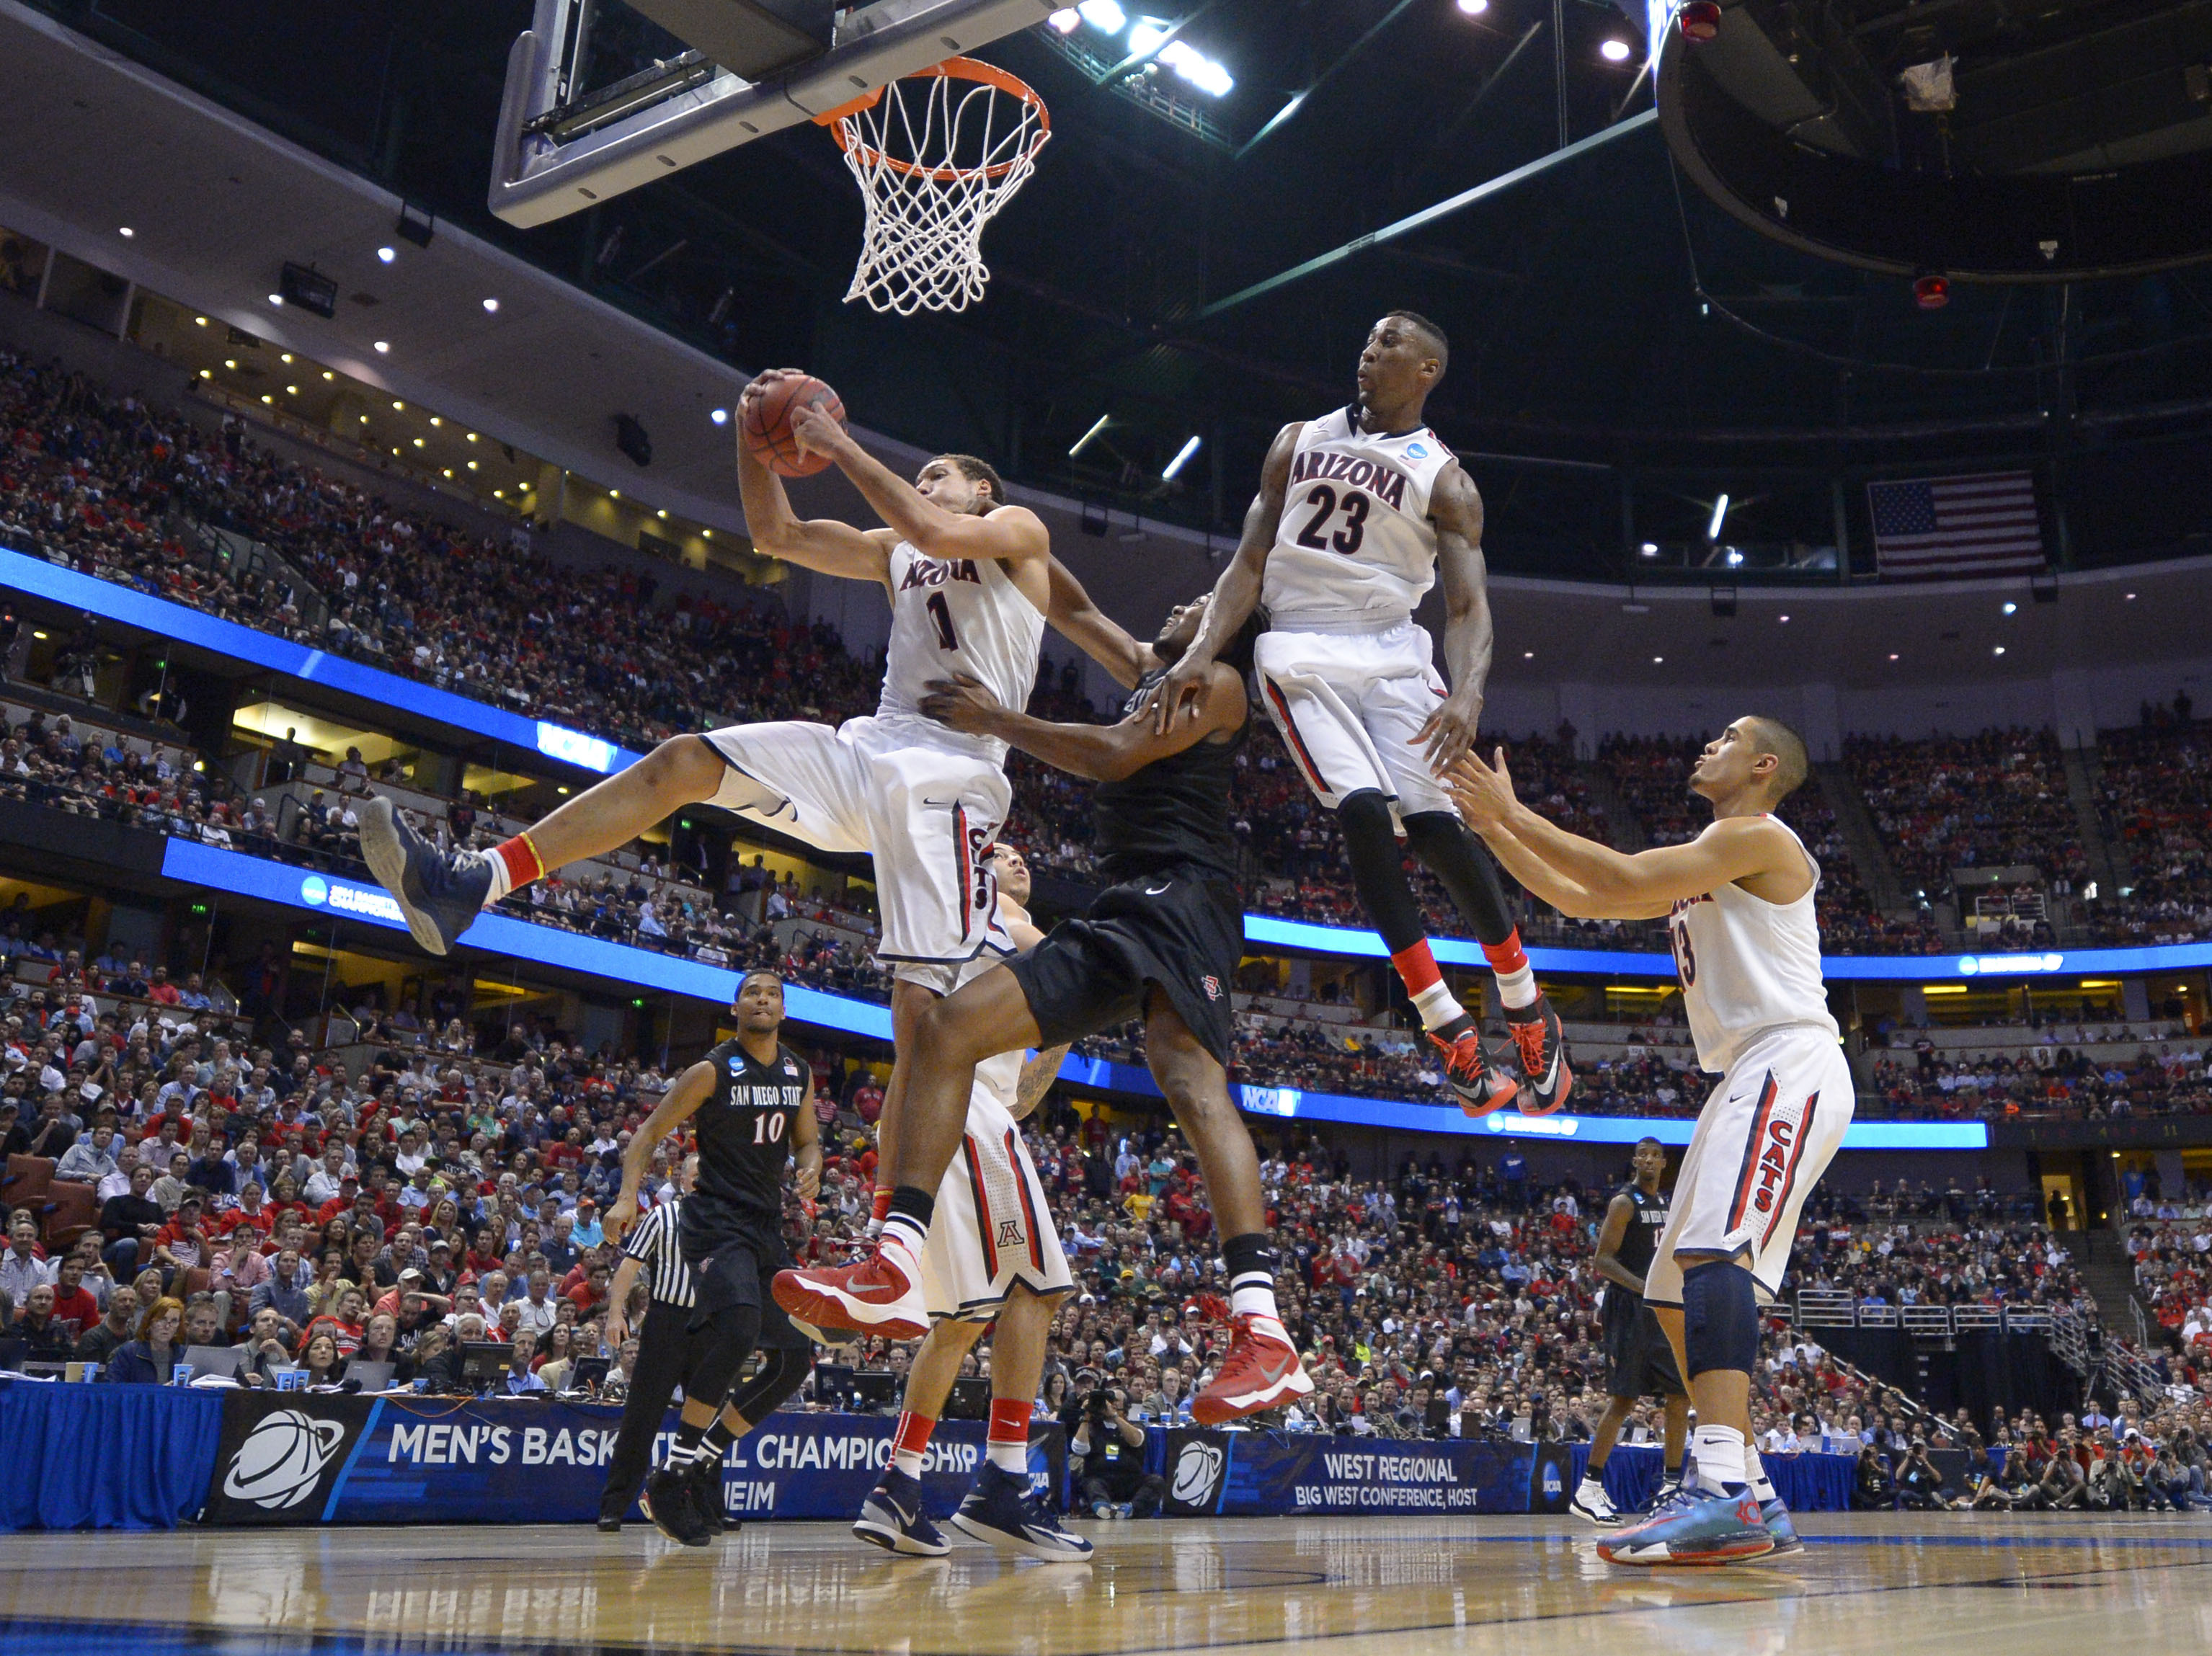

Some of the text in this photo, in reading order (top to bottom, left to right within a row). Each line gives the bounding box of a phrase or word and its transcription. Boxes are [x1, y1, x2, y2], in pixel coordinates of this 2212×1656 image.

[1291, 452, 1406, 512] ARIZONA
[1296, 484, 1370, 555] 23
[926, 590, 959, 651] 1
[730, 1085, 750, 1105] SAN
[752, 1085, 780, 1105] DIEGO
[752, 1112, 786, 1145] 10
[1754, 1120, 1793, 1213] CATS
[998, 1220, 1024, 1247] A
[388, 1424, 512, 1464] MEN'S
[757, 1435, 977, 1473] CHAMPIOSHIP
[1324, 1454, 1458, 1482] WEST REGIONAL
[1295, 1486, 1478, 1510] BIG WEST CONFERENCE, HOST
